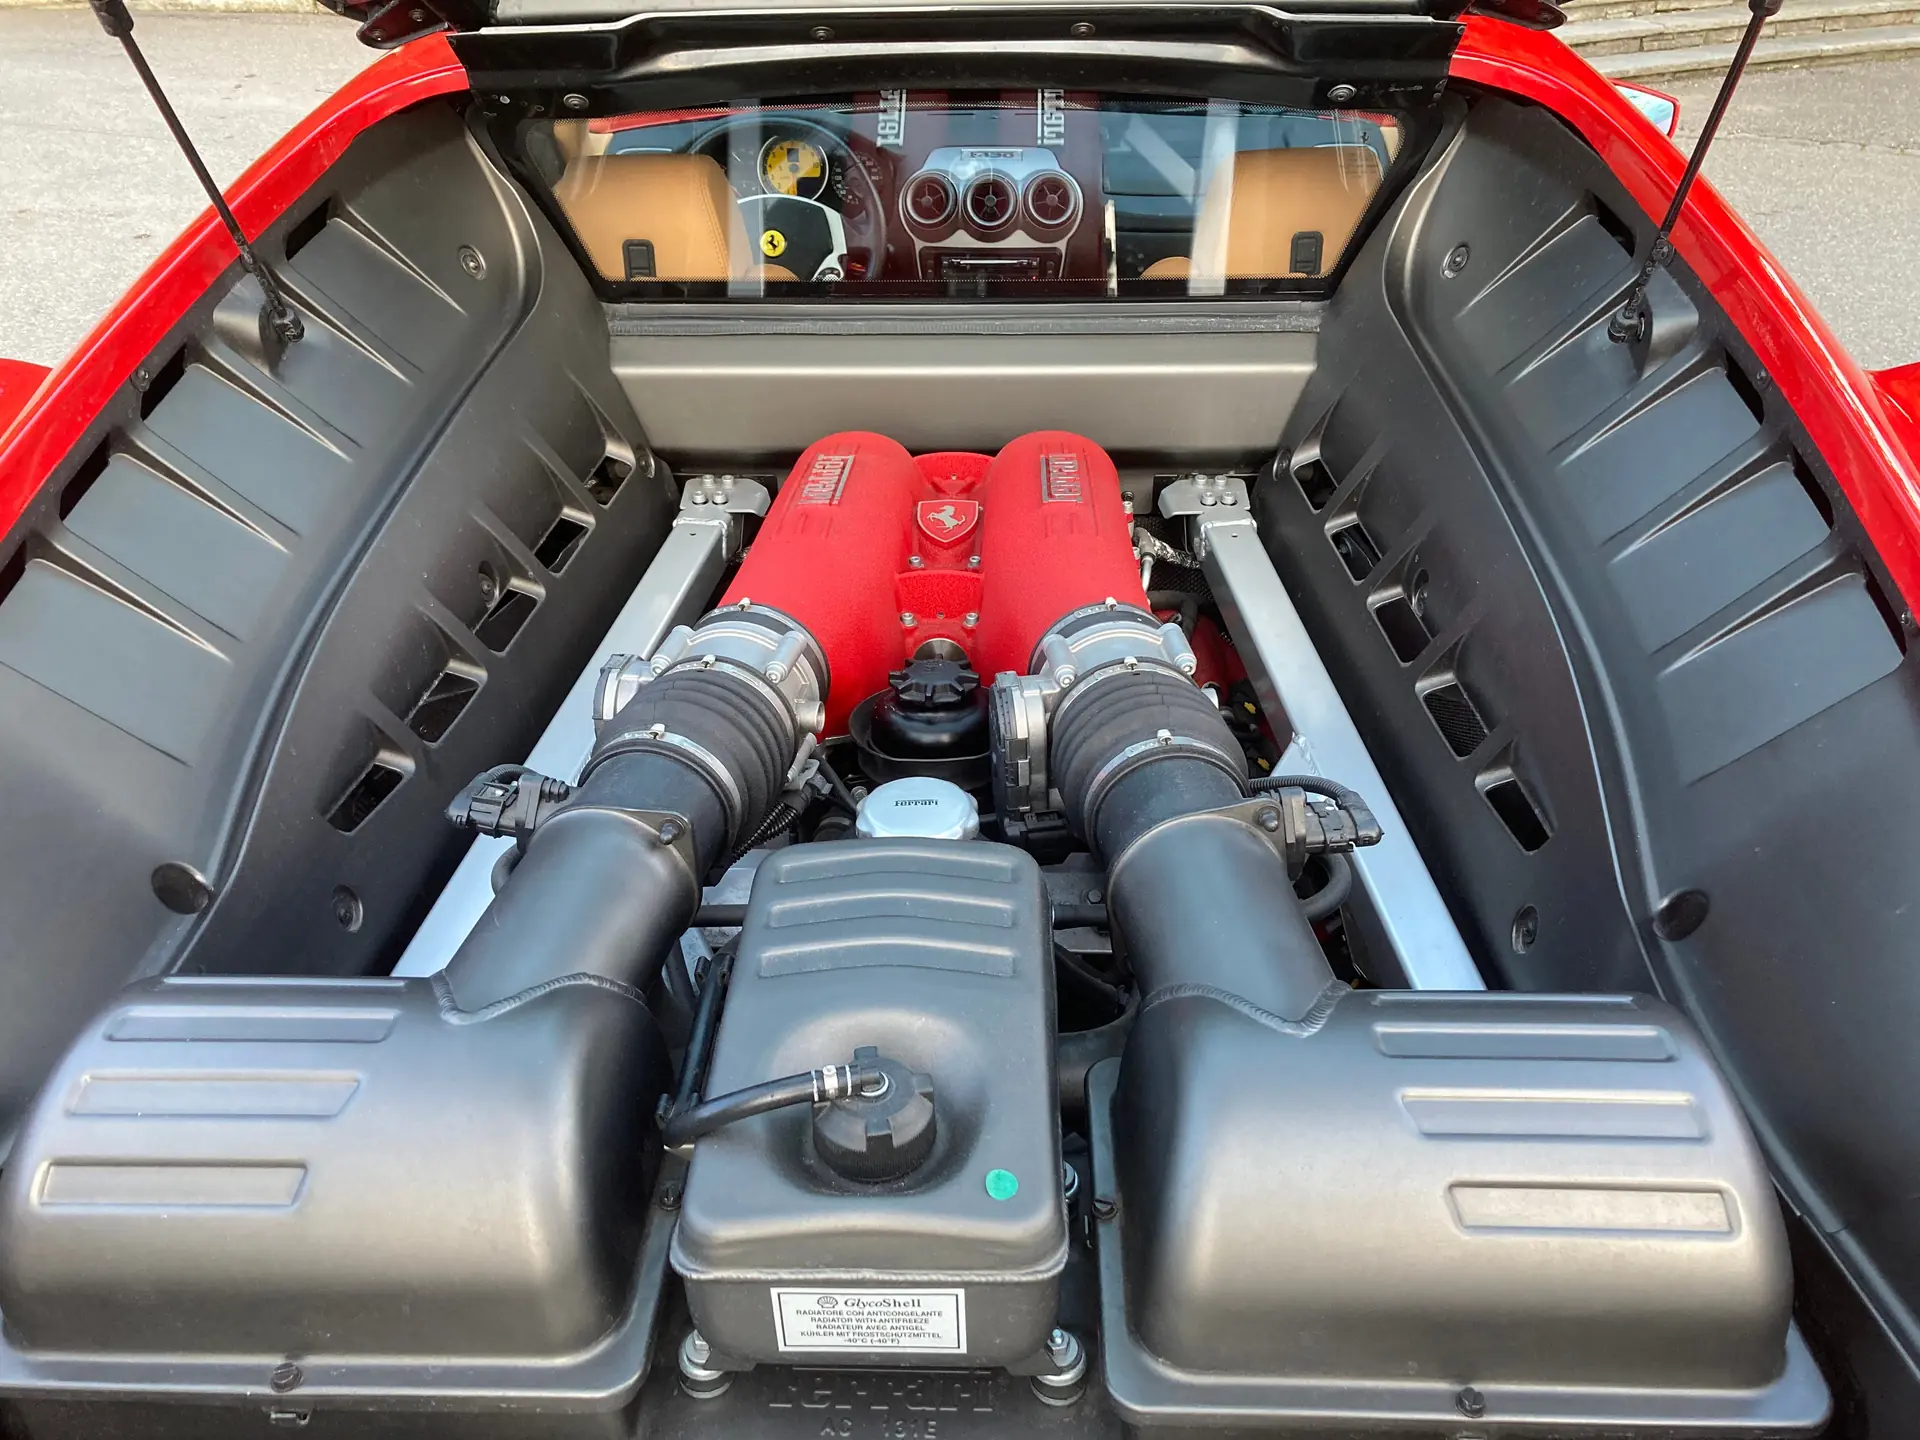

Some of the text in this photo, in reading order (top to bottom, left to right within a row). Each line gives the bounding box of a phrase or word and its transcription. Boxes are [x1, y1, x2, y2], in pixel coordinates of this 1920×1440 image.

[798, 453, 855, 505] Ferrari
[1040, 453, 1083, 503] Ferrari
[894, 798, 939, 807] Ferrari
[844, 1297, 921, 1309] GlycoShell
